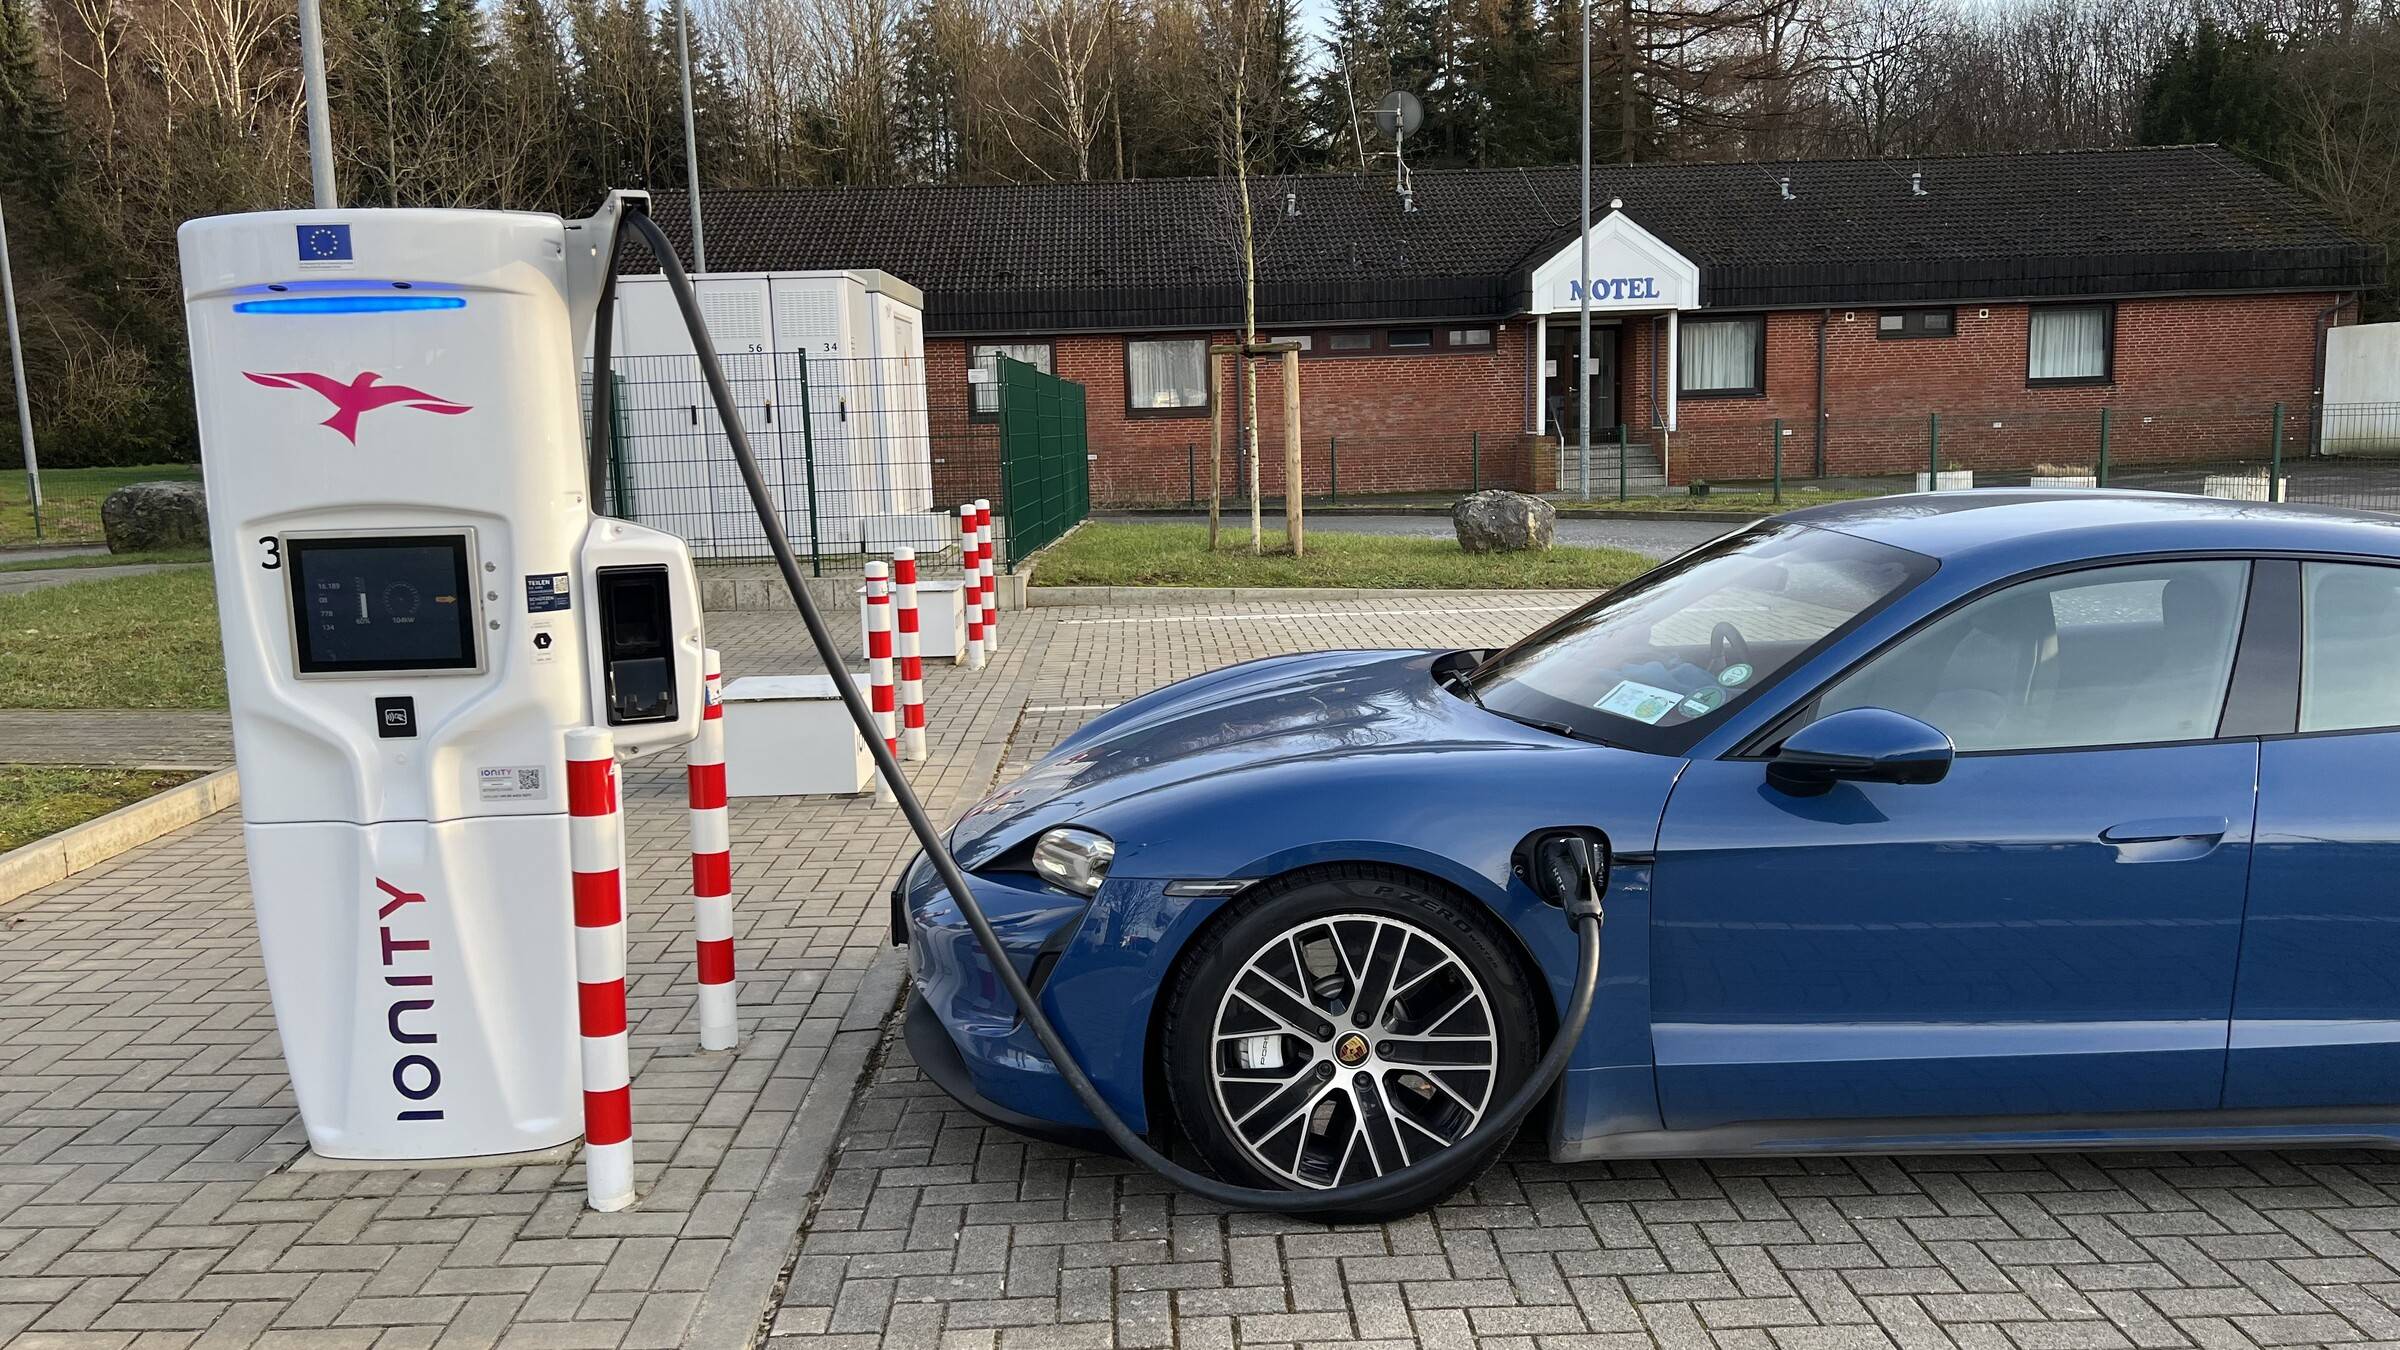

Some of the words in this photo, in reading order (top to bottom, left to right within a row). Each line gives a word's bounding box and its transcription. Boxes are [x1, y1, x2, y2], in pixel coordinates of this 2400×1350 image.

[1570, 277, 1660, 301] MOTEL
[259, 536, 281, 570] 3
[481, 769, 512, 777] IONITY
[1374, 885, 1394, 895] P
[1400, 891, 1472, 933] ZERO
[376, 877, 444, 1121] IONITY
